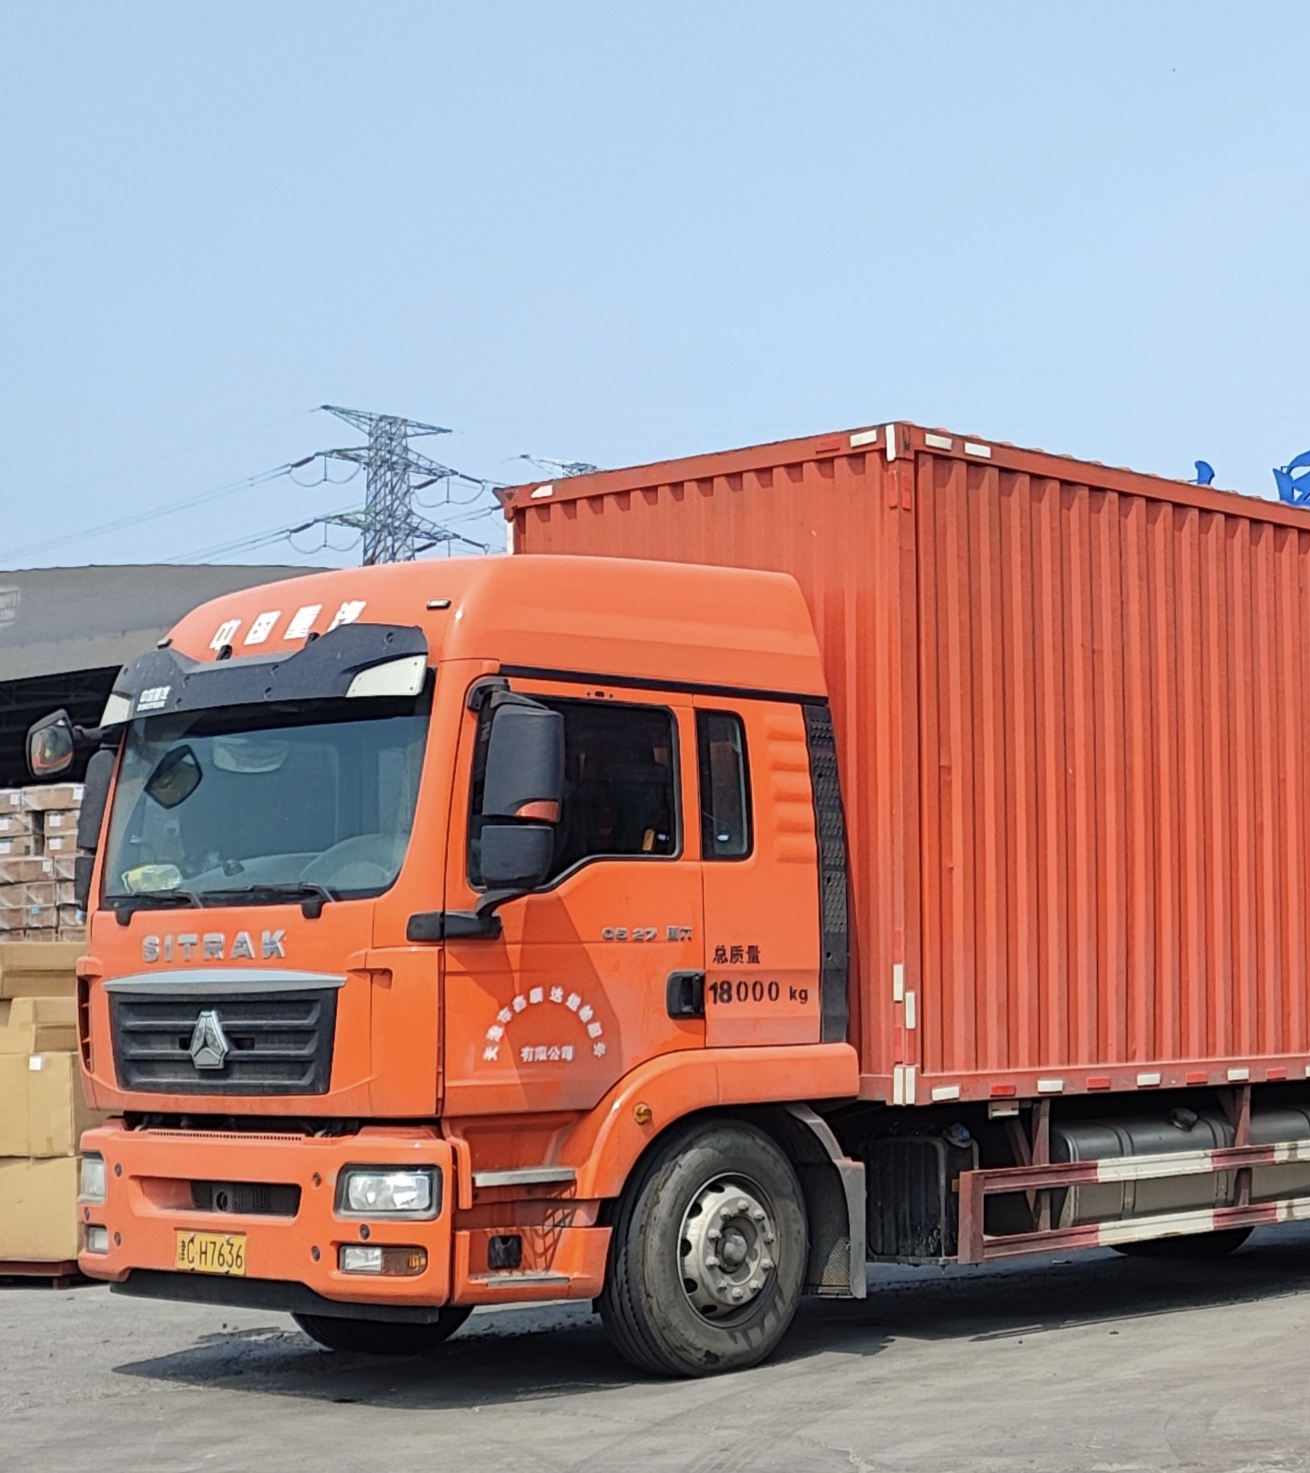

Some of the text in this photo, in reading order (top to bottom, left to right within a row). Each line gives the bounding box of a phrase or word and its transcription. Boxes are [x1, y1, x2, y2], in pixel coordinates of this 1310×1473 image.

[142, 929, 287, 963] SITRAK
[713, 945, 761, 964] 总质量
[708, 980, 808, 1004] 18000 kg
[520, 1045, 574, 1062] 有限公司
